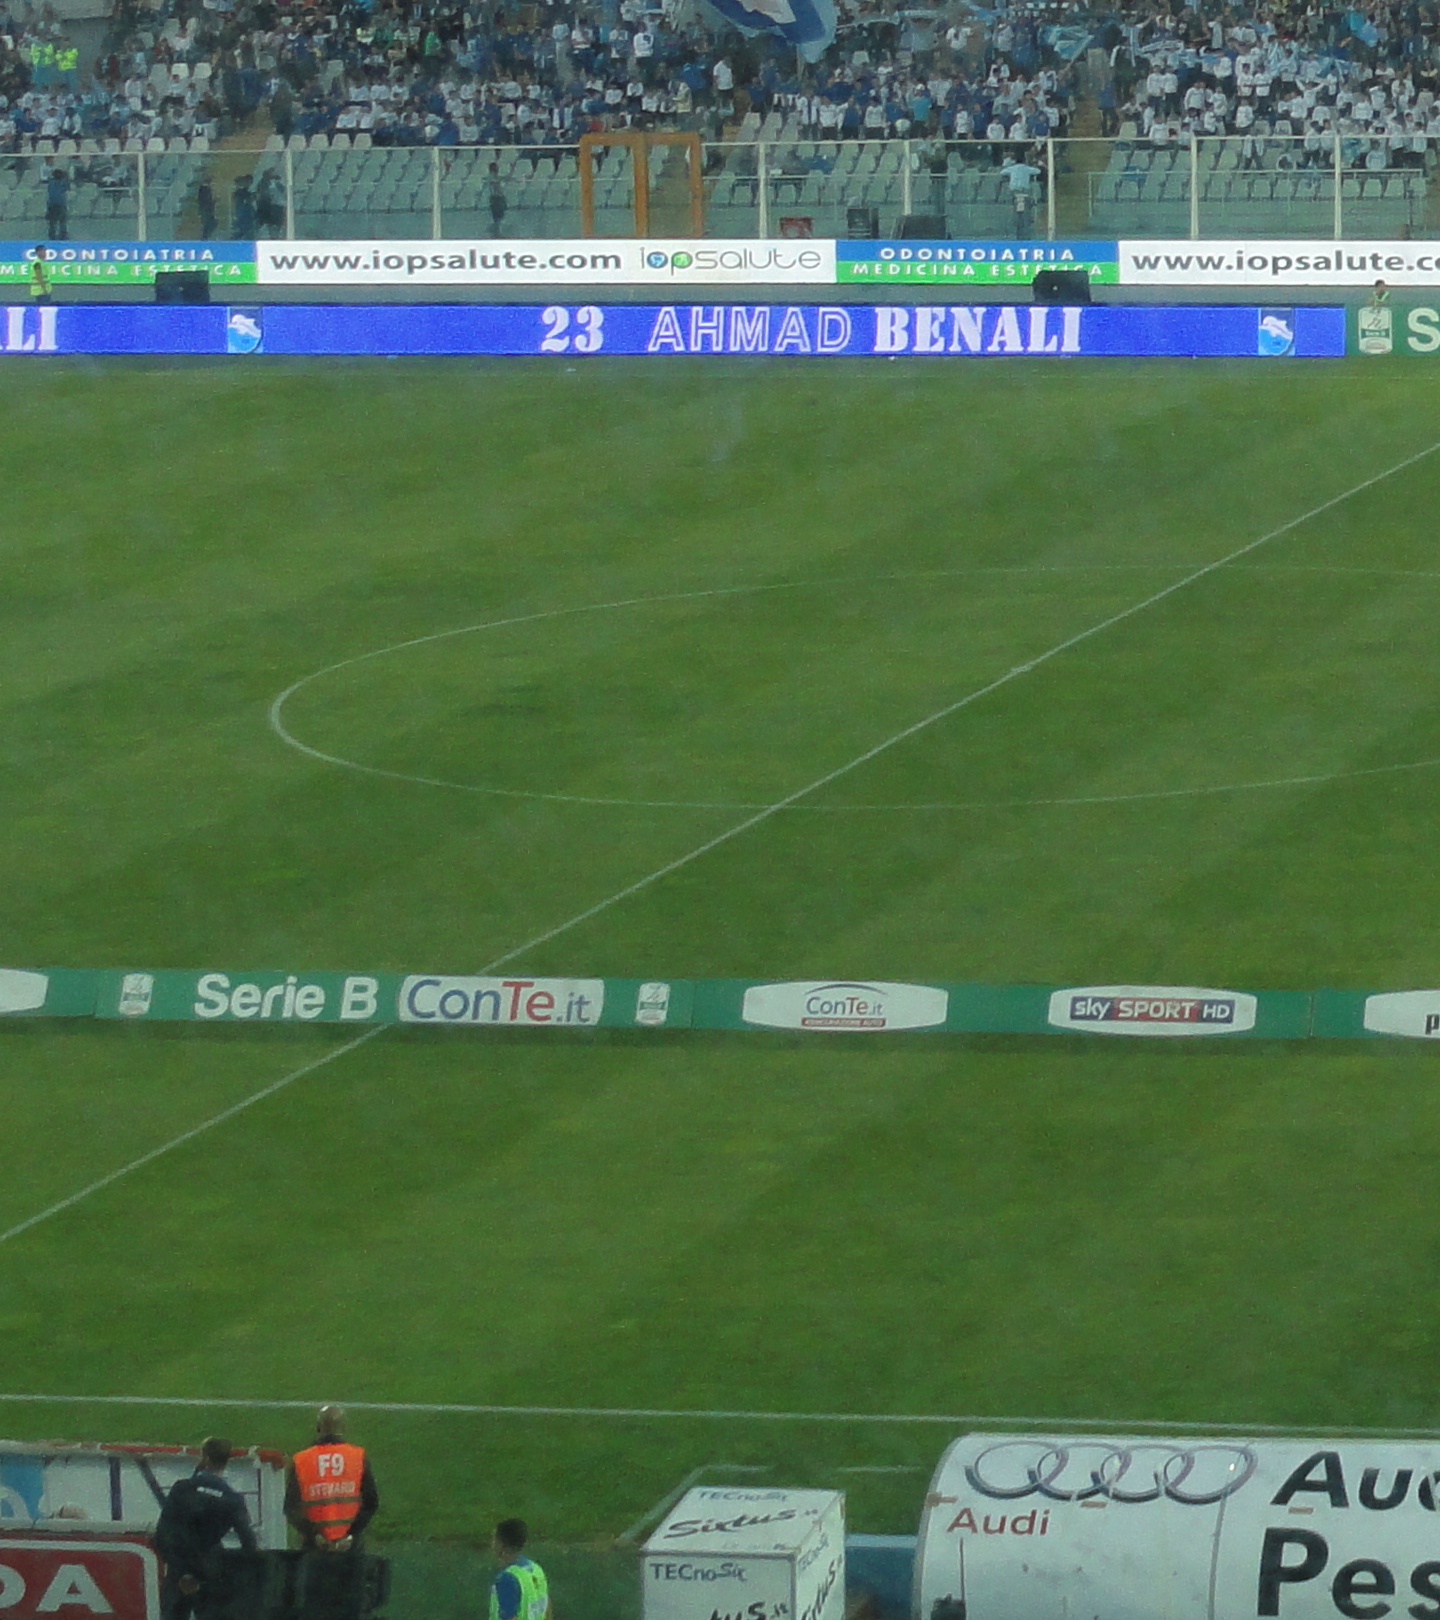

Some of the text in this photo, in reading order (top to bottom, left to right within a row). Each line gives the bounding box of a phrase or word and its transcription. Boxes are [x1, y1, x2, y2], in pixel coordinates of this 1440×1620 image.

[270, 248, 621, 275] www.iopsalute.com
[641, 247, 820, 276] iopsalute
[880, 248, 1075, 261] ODONTOIATRIA
[0, 265, 118, 276] MEICINA
[853, 264, 976, 276] MEDICINA
[541, 306, 1082, 353] 23 AHMAD BENALI
[194, 974, 379, 1019] Serie B
[407, 978, 592, 1023] ConTe.it
[806, 996, 883, 1016] ConTe.it
[1075, 997, 1231, 1020] sky SPORT HD
[318, 1453, 345, 1477] F9
[309, 1481, 356, 1498] STEWARD
[946, 1508, 1050, 1536] Audi
